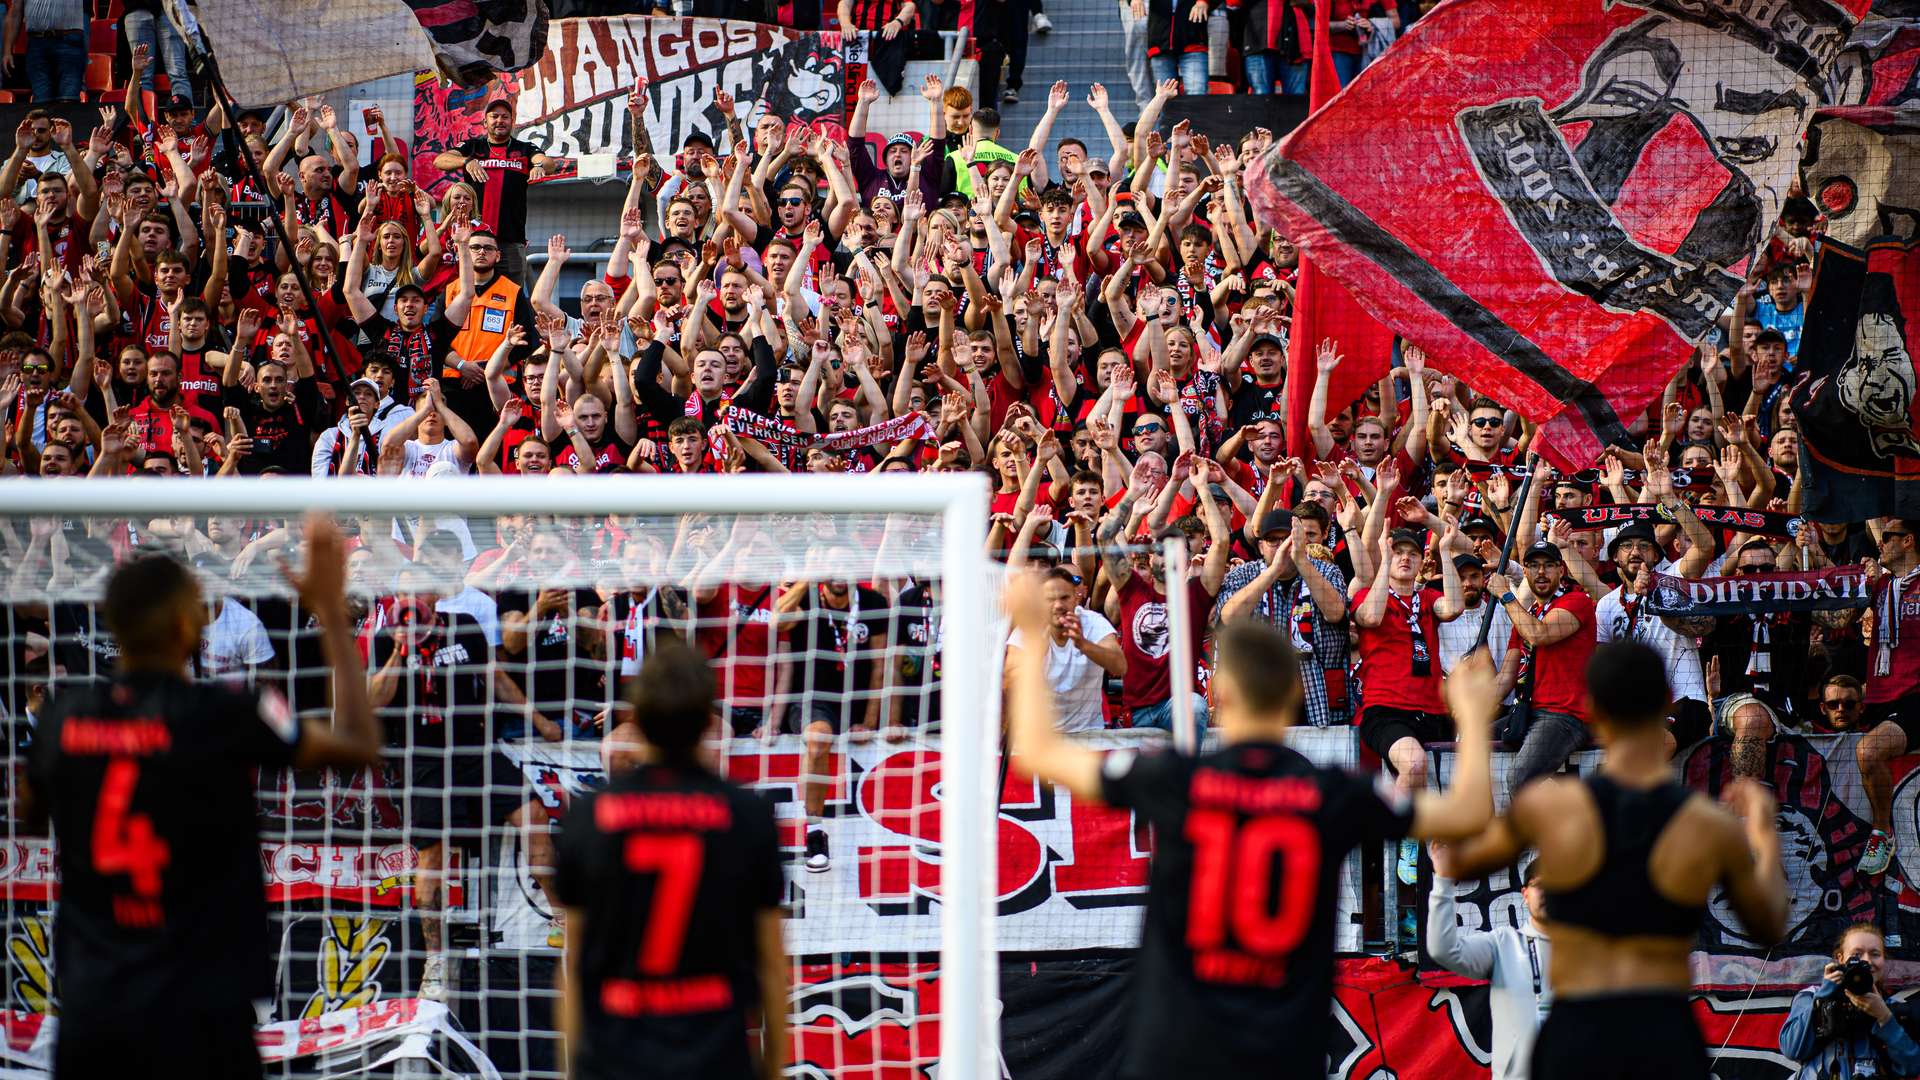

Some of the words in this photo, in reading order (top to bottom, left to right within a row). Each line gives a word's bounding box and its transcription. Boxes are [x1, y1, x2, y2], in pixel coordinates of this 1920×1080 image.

[486, 316, 501, 325] 663
[726, 416, 808, 447] EVERKUSEN
[1689, 573, 1868, 604] DIFFIDATI
[91, 757, 171, 897] 4
[623, 833, 704, 976] 7
[1187, 810, 1322, 957] 10
